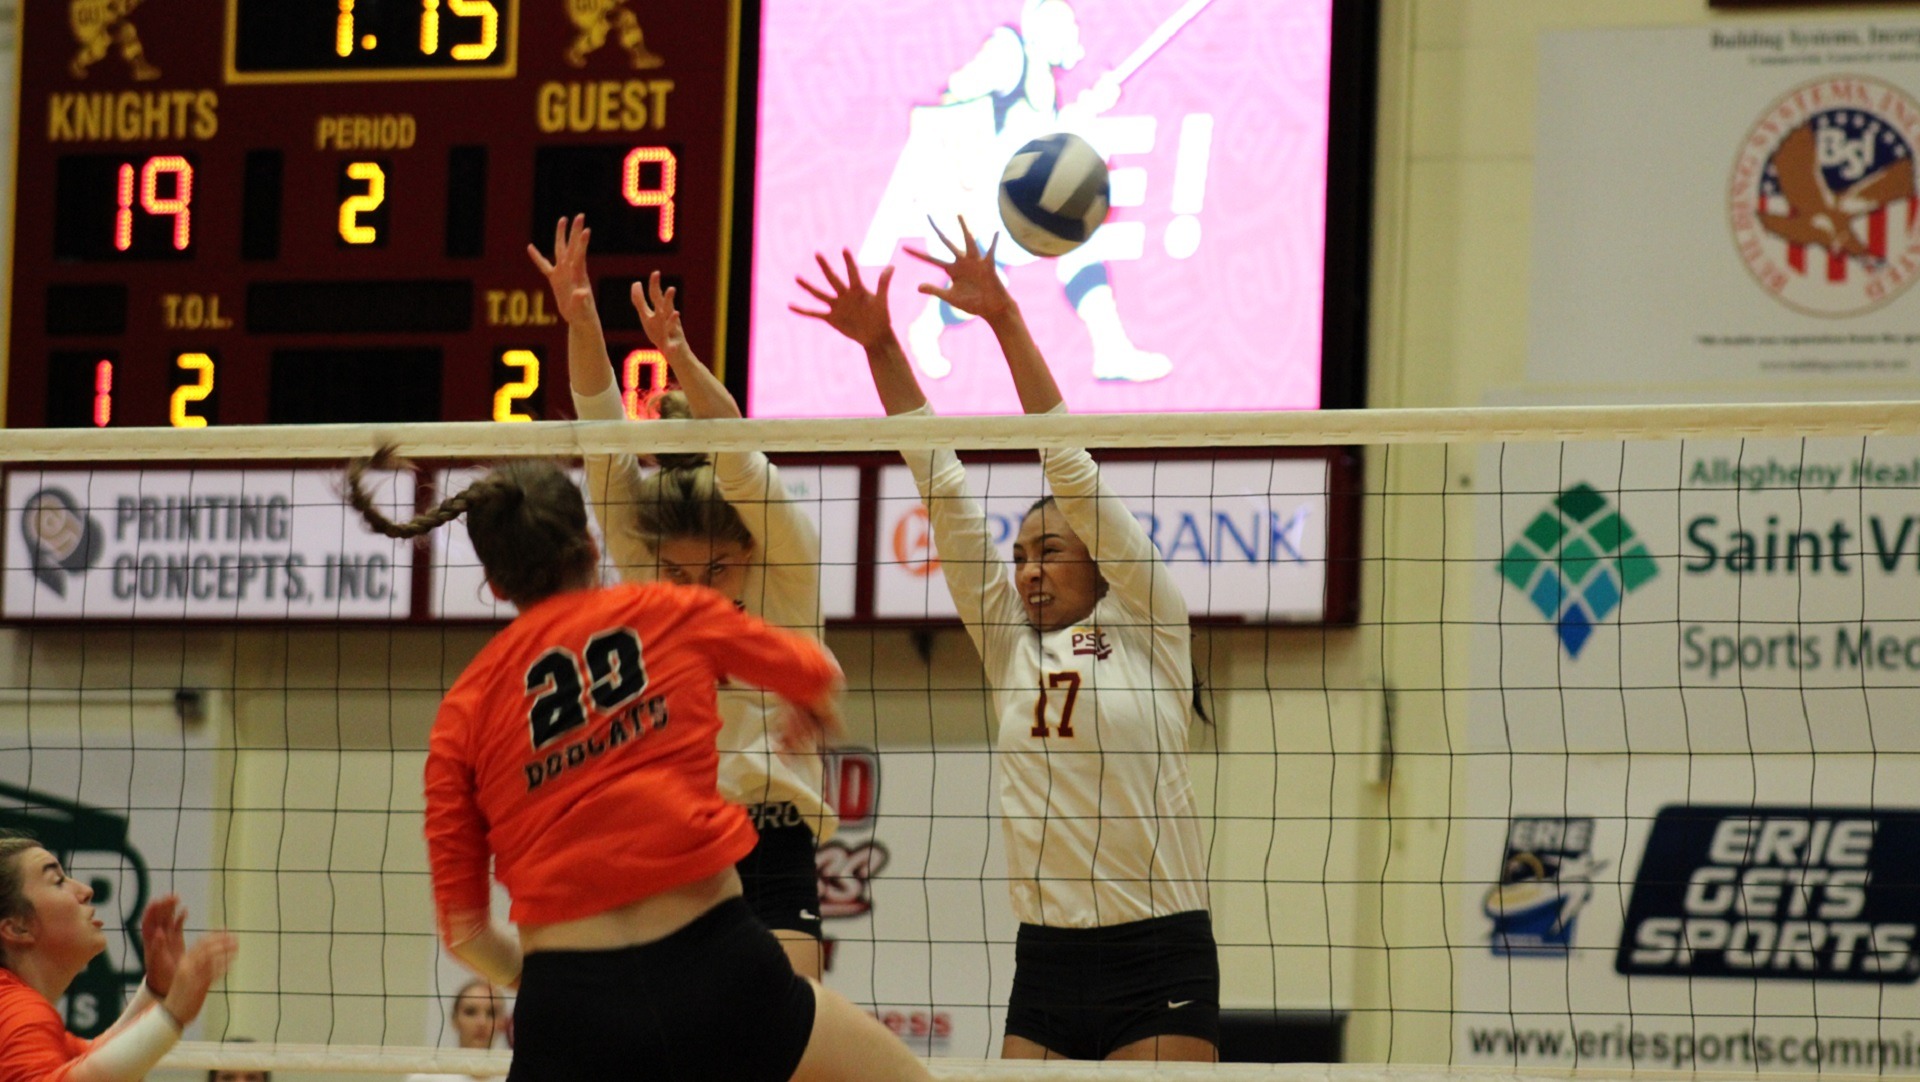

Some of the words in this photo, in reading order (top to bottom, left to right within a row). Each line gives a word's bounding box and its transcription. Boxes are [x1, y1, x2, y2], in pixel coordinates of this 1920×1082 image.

[48, 91, 218, 142] KNIGHTS
[317, 115, 416, 149] PERIOD
[538, 80, 674, 132] GUEST
[117, 156, 194, 251] 19
[339, 162, 386, 244] 2
[622, 147, 677, 243] 9
[858, 106, 1213, 266] AE!
[164, 297, 232, 330] T.O.L.
[487, 290, 559, 326] T.O.L.
[95, 359, 113, 427] 1
[170, 353, 215, 428] 2
[494, 350, 540, 422] 2
[1689, 459, 1842, 492] Allegheny
[116, 493, 290, 543] PRINTING
[1685, 514, 1852, 574] Saint
[113, 552, 313, 604] CONCEPTS,
[324, 556, 397, 601] INC.
[1684, 625, 1822, 681] Sports
[1031, 670, 1082, 738] 17
[1512, 818, 1590, 851] ERIE
[1709, 820, 1877, 866] ERIE
[1684, 866, 1872, 919] GETS
[1630, 918, 1915, 972] SPORTS
[1470, 1024, 1920, 1070] www.eriesportscommi
